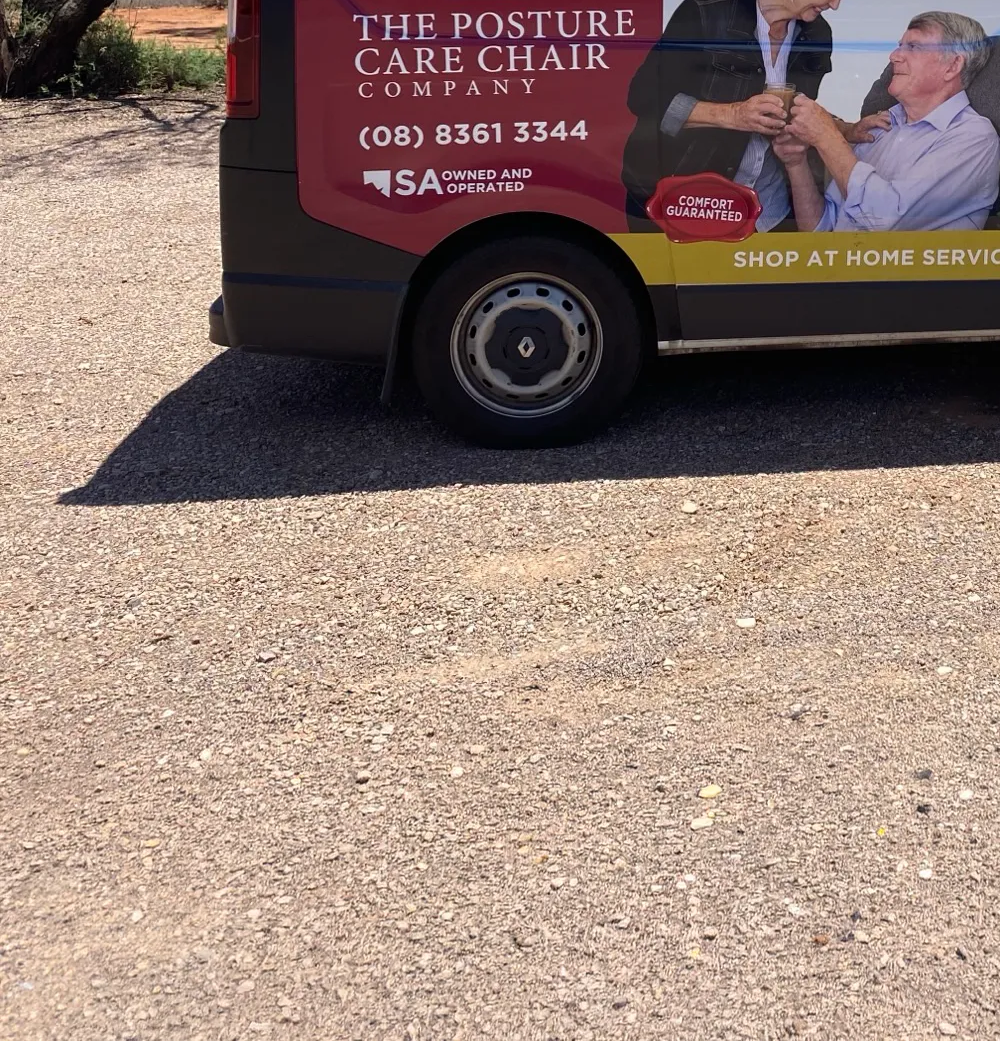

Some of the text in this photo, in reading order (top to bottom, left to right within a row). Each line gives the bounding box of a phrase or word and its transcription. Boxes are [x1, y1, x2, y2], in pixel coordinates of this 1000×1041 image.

[353, 9, 636, 41] THE POSTURE
[354, 43, 610, 76] CARE CHAIR
[358, 78, 536, 98] COMPANY
[359, 120, 588, 150] (08) 8361 3344
[395, 168, 532, 196] SA OWNED AND
[446, 181, 525, 194] OPERATED
[678, 195, 734, 210] COMFORT
[666, 205, 743, 223] GUARANTEED
[733, 250, 799, 268] SHOP
[806, 250, 836, 267] AT
[847, 249, 914, 266] HOME
